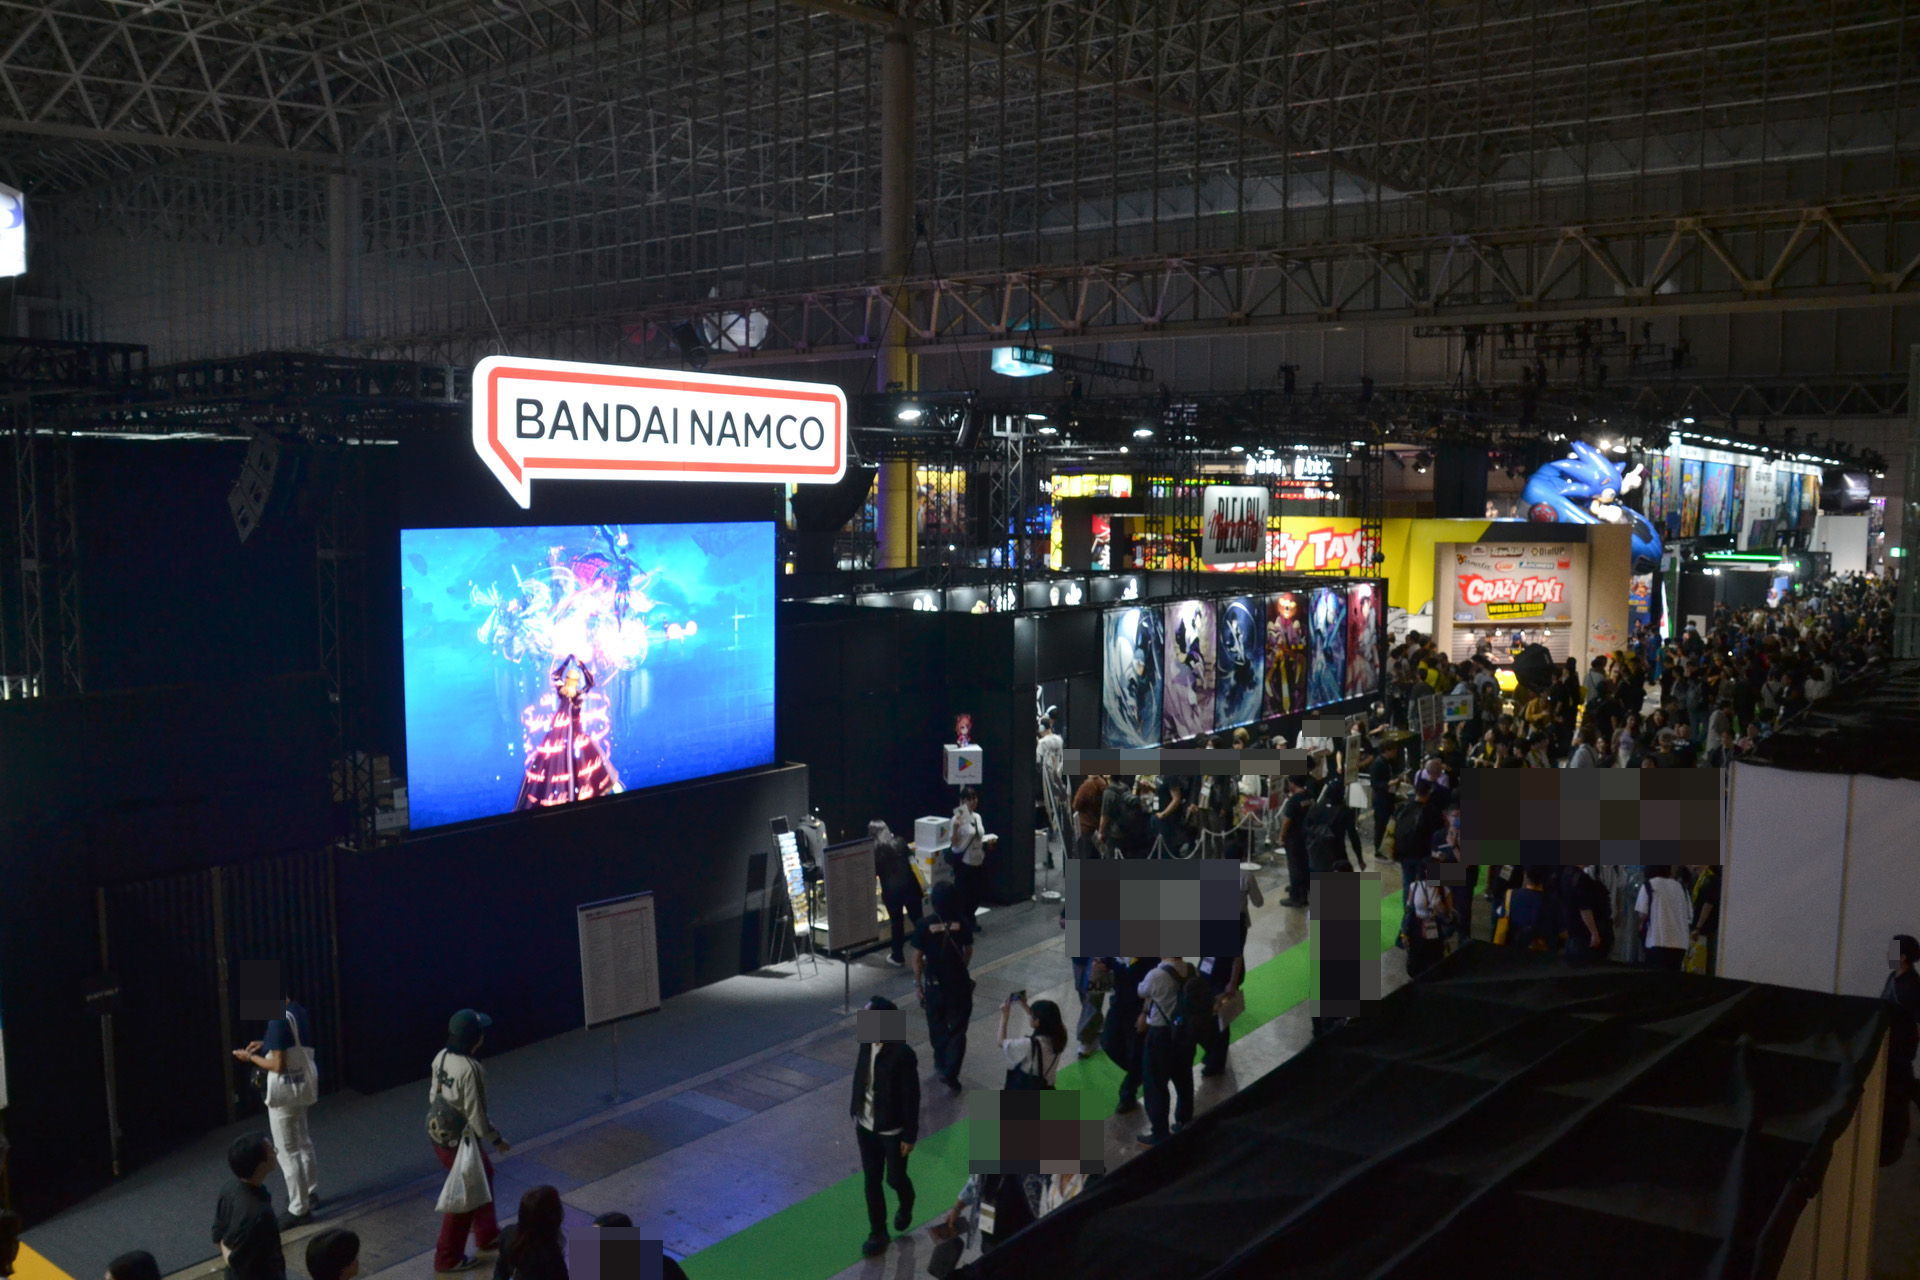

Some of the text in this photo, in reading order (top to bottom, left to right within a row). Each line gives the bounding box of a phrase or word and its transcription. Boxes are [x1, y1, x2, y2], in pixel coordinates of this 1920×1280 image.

[516, 397, 825, 451] BANDAI NAMCO
[1466, 576, 1562, 604] CRAZY TAXI
[1489, 603, 1544, 613] WORLD TOUR
